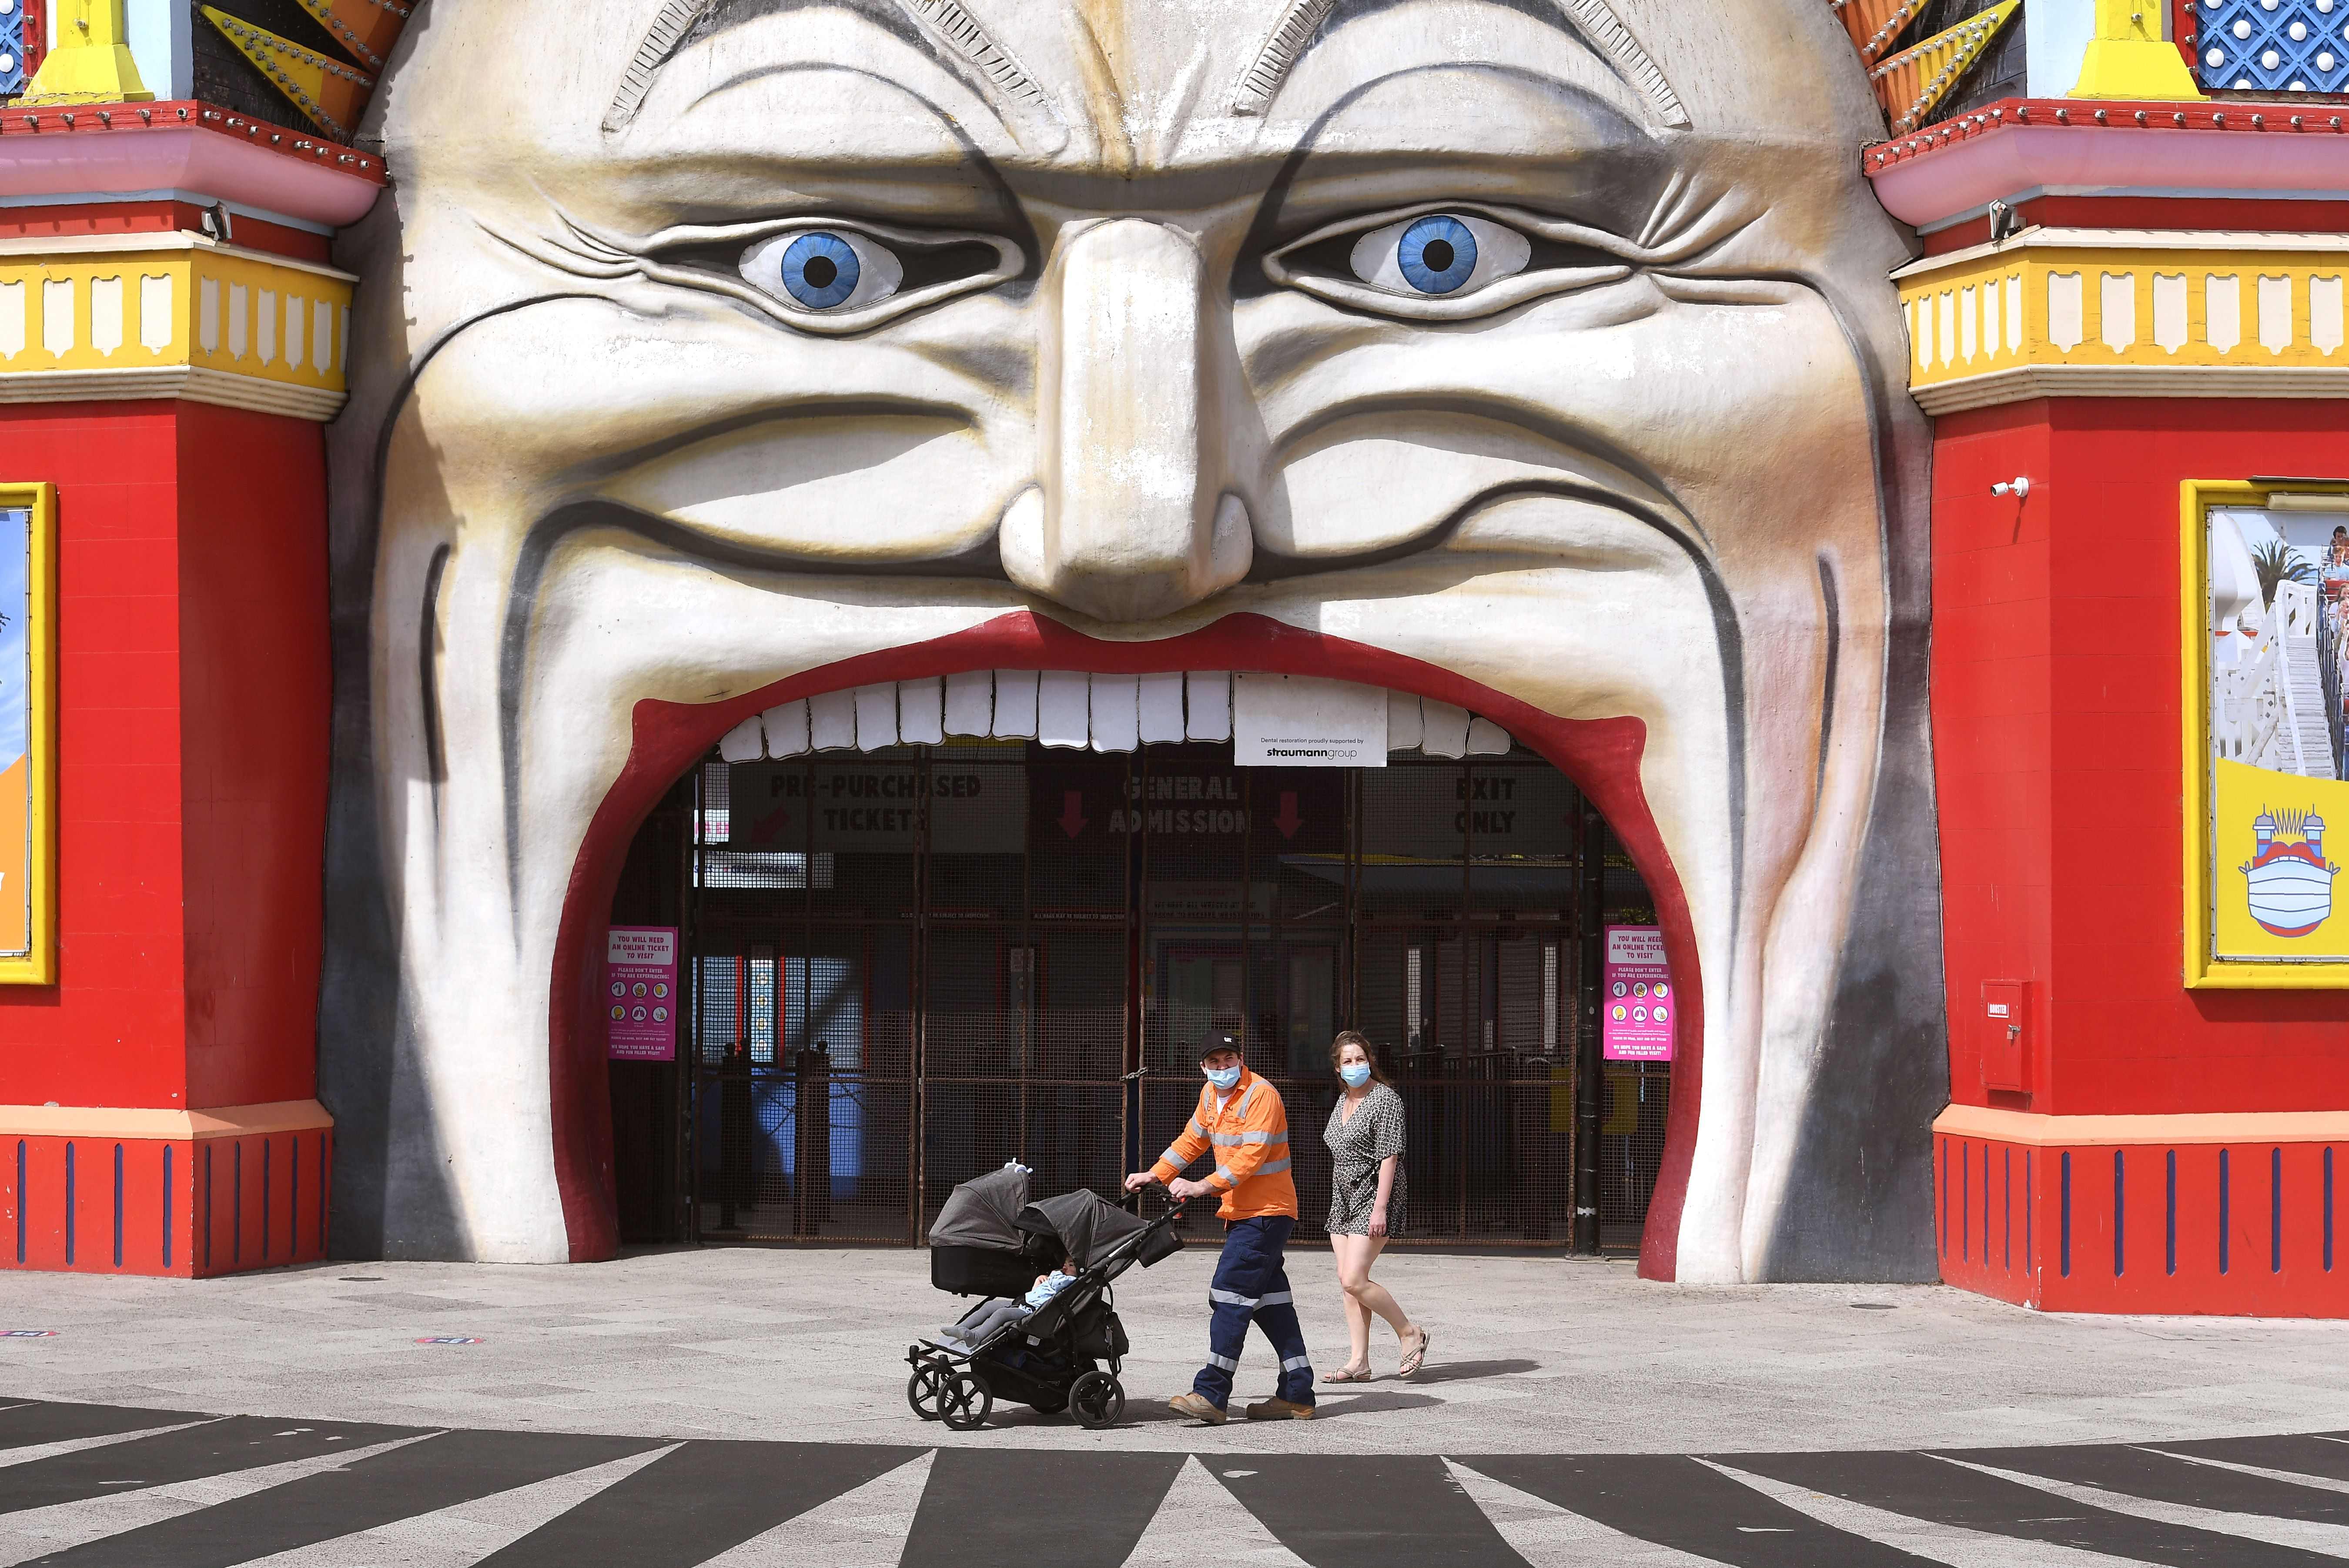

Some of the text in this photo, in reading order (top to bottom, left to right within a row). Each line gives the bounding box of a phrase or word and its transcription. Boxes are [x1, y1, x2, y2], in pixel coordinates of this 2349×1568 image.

[1267, 748, 1357, 760] straumanngroup
[1456, 777, 1516, 800] EXIT
[1454, 810, 1516, 833] ONLY
